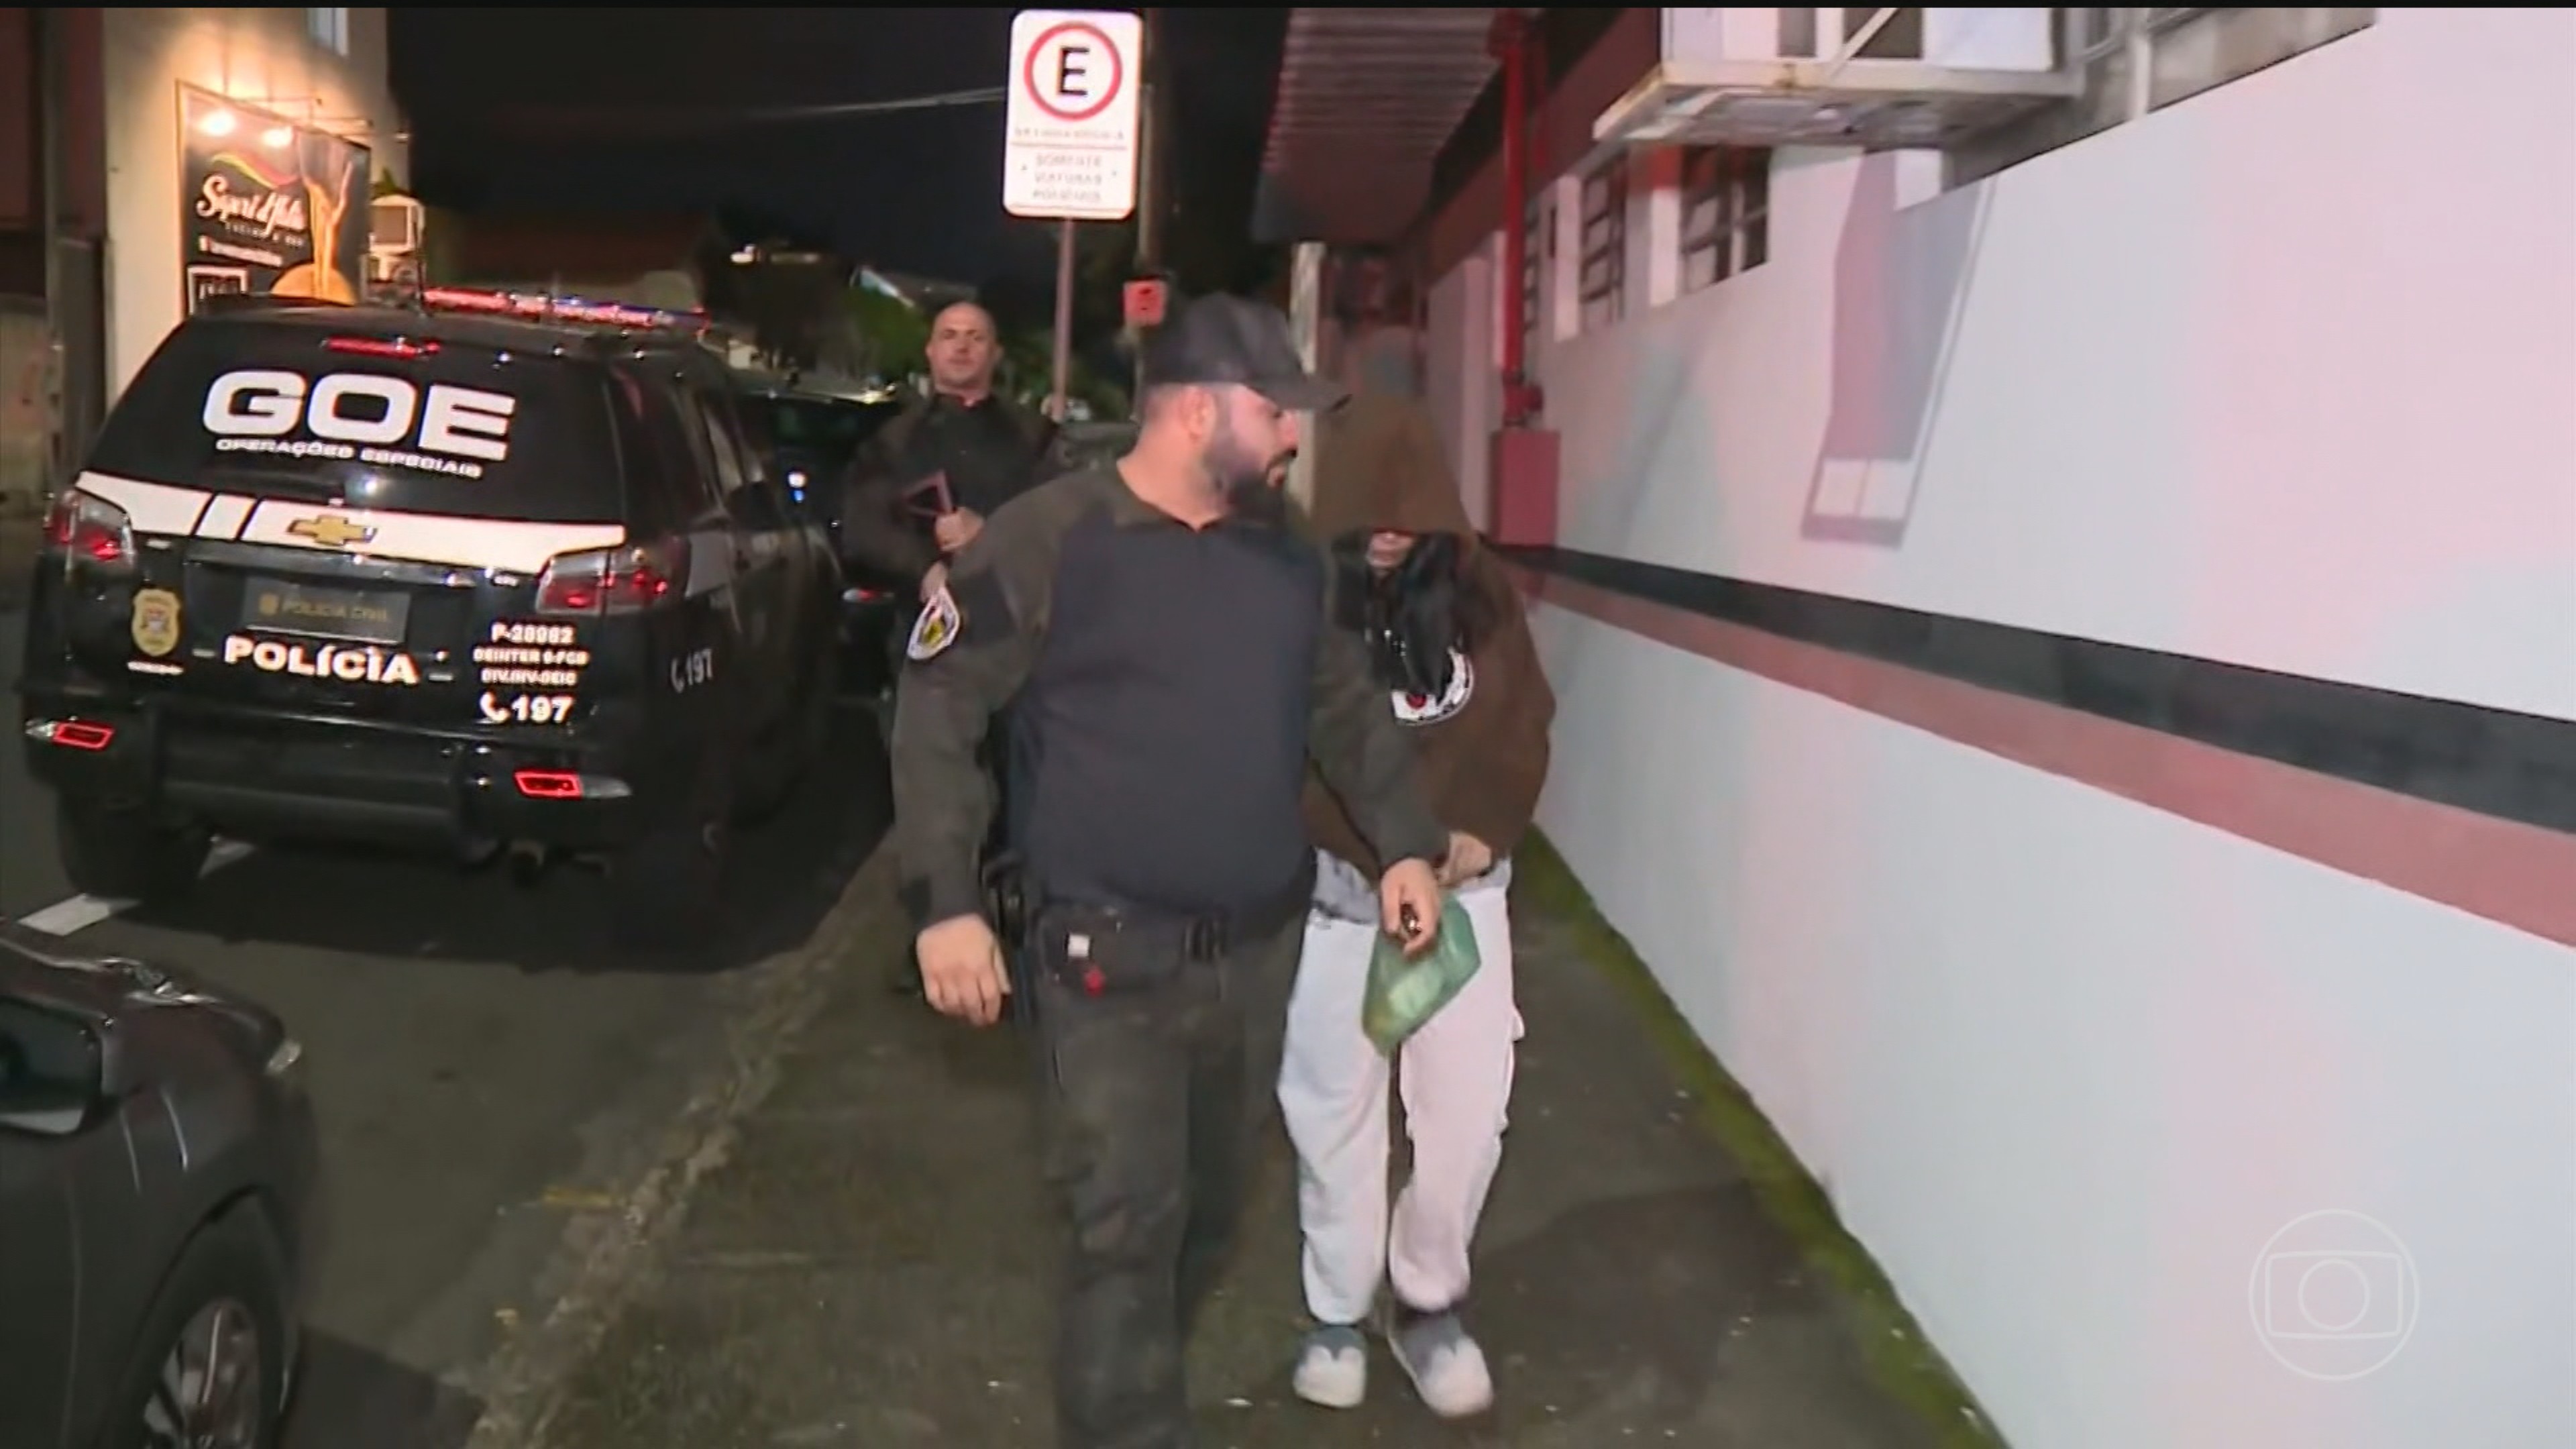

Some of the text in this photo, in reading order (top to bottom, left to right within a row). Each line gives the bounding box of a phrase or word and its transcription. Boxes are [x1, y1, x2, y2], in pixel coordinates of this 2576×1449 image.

[1057, 46, 1090, 96] E
[203, 370, 516, 461] GOE
[215, 438, 354, 459] OPERAÇÕES
[685, 649, 714, 685] 197
[511, 695, 574, 724] 197
